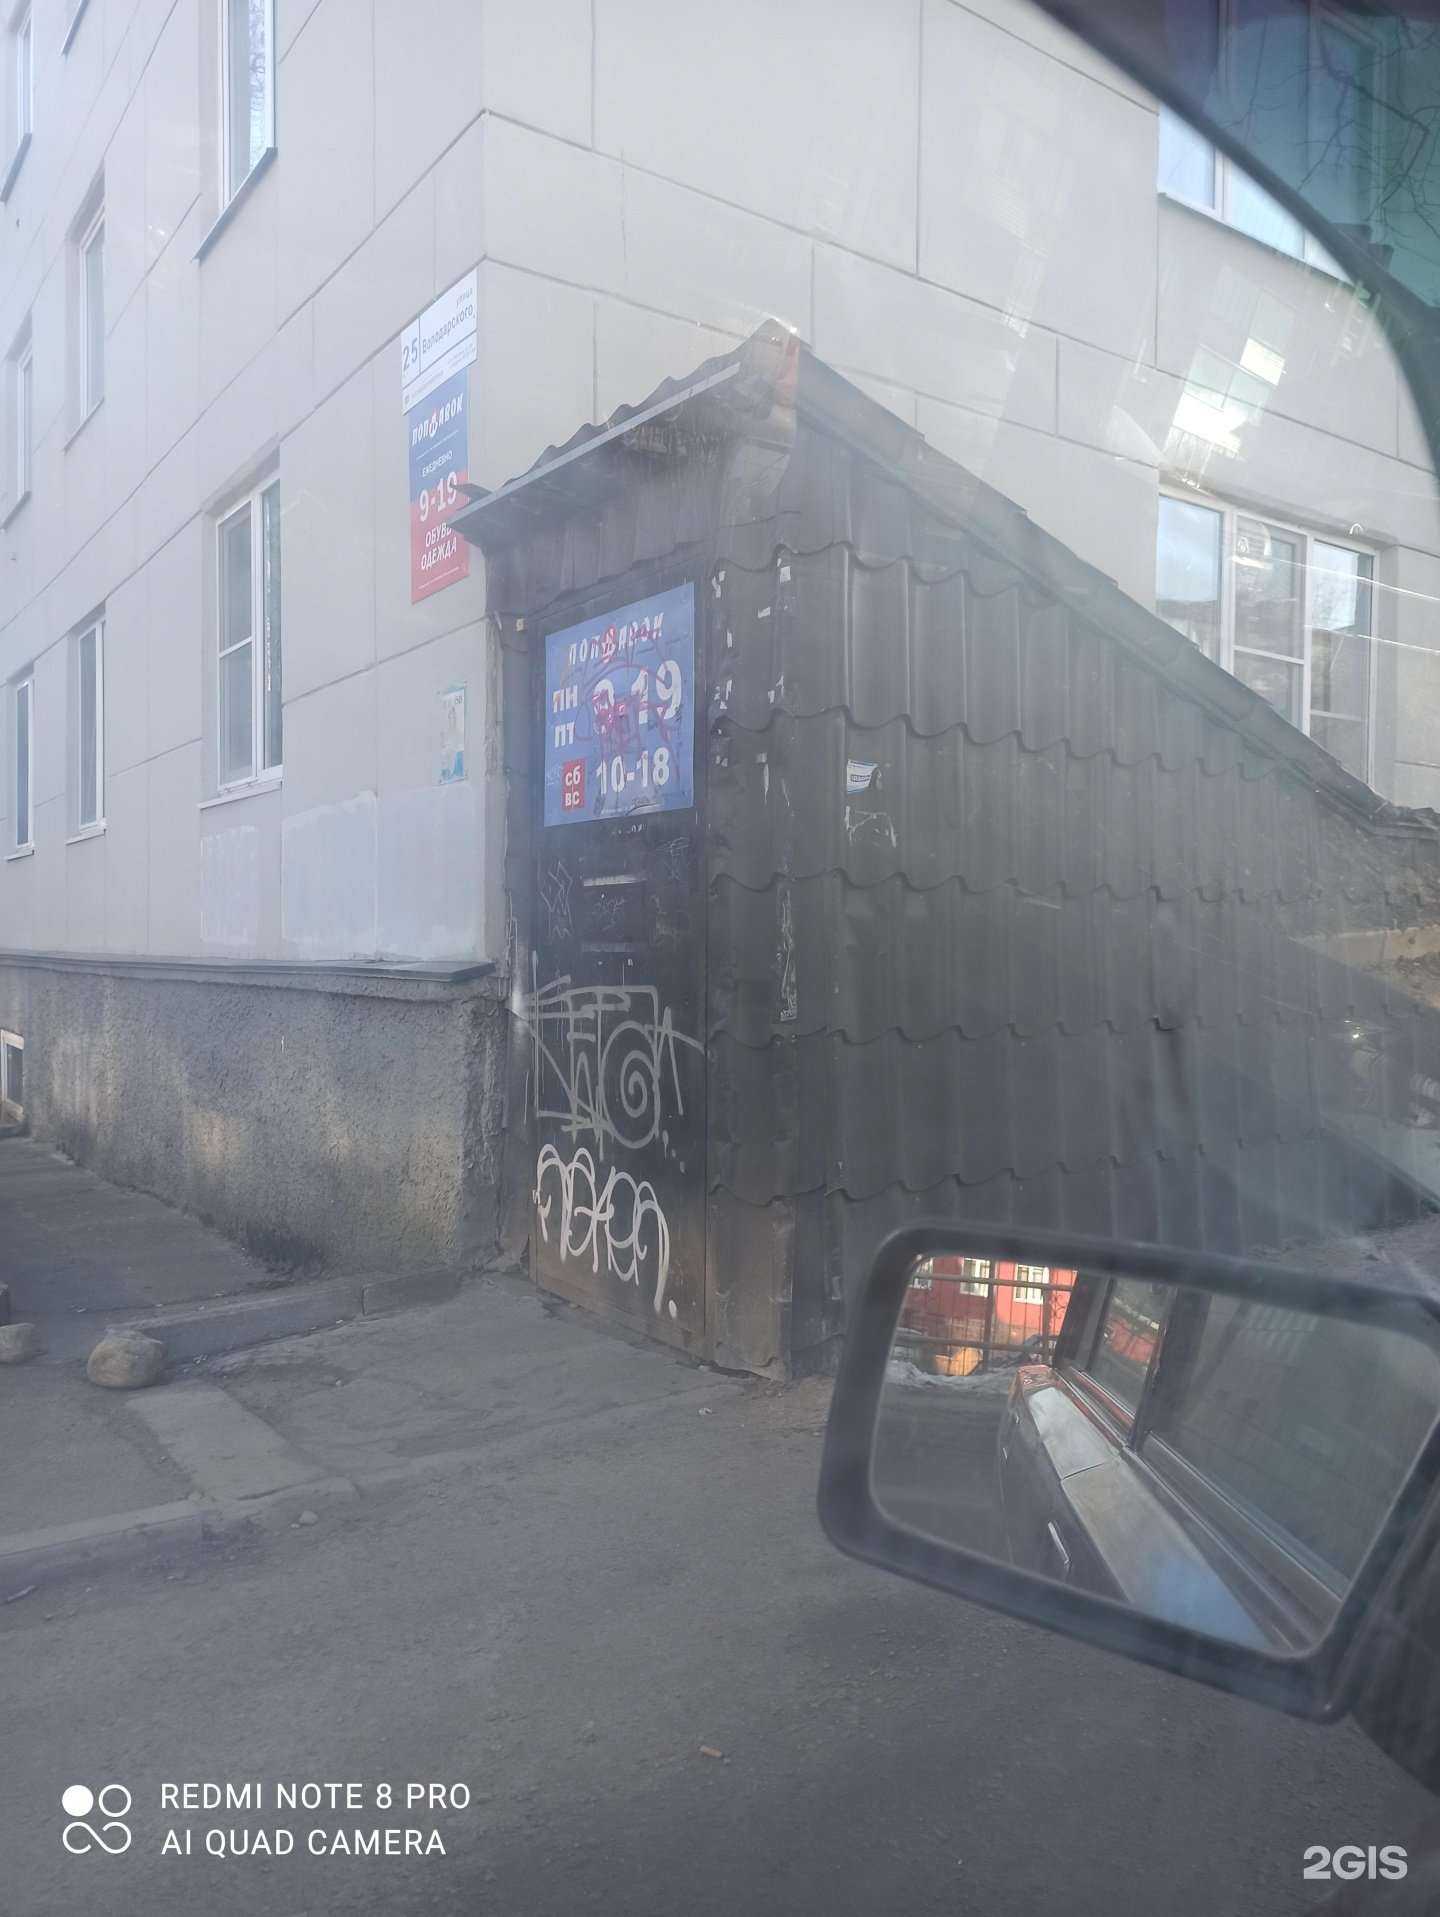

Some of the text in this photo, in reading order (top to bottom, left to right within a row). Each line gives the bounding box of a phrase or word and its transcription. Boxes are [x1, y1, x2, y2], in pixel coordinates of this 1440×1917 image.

[403, 337, 418, 372] 25
[419, 471, 458, 522] 9-19
[420, 537, 457, 571] ОДЕЖДА
[596, 747, 670, 795] 10-18
